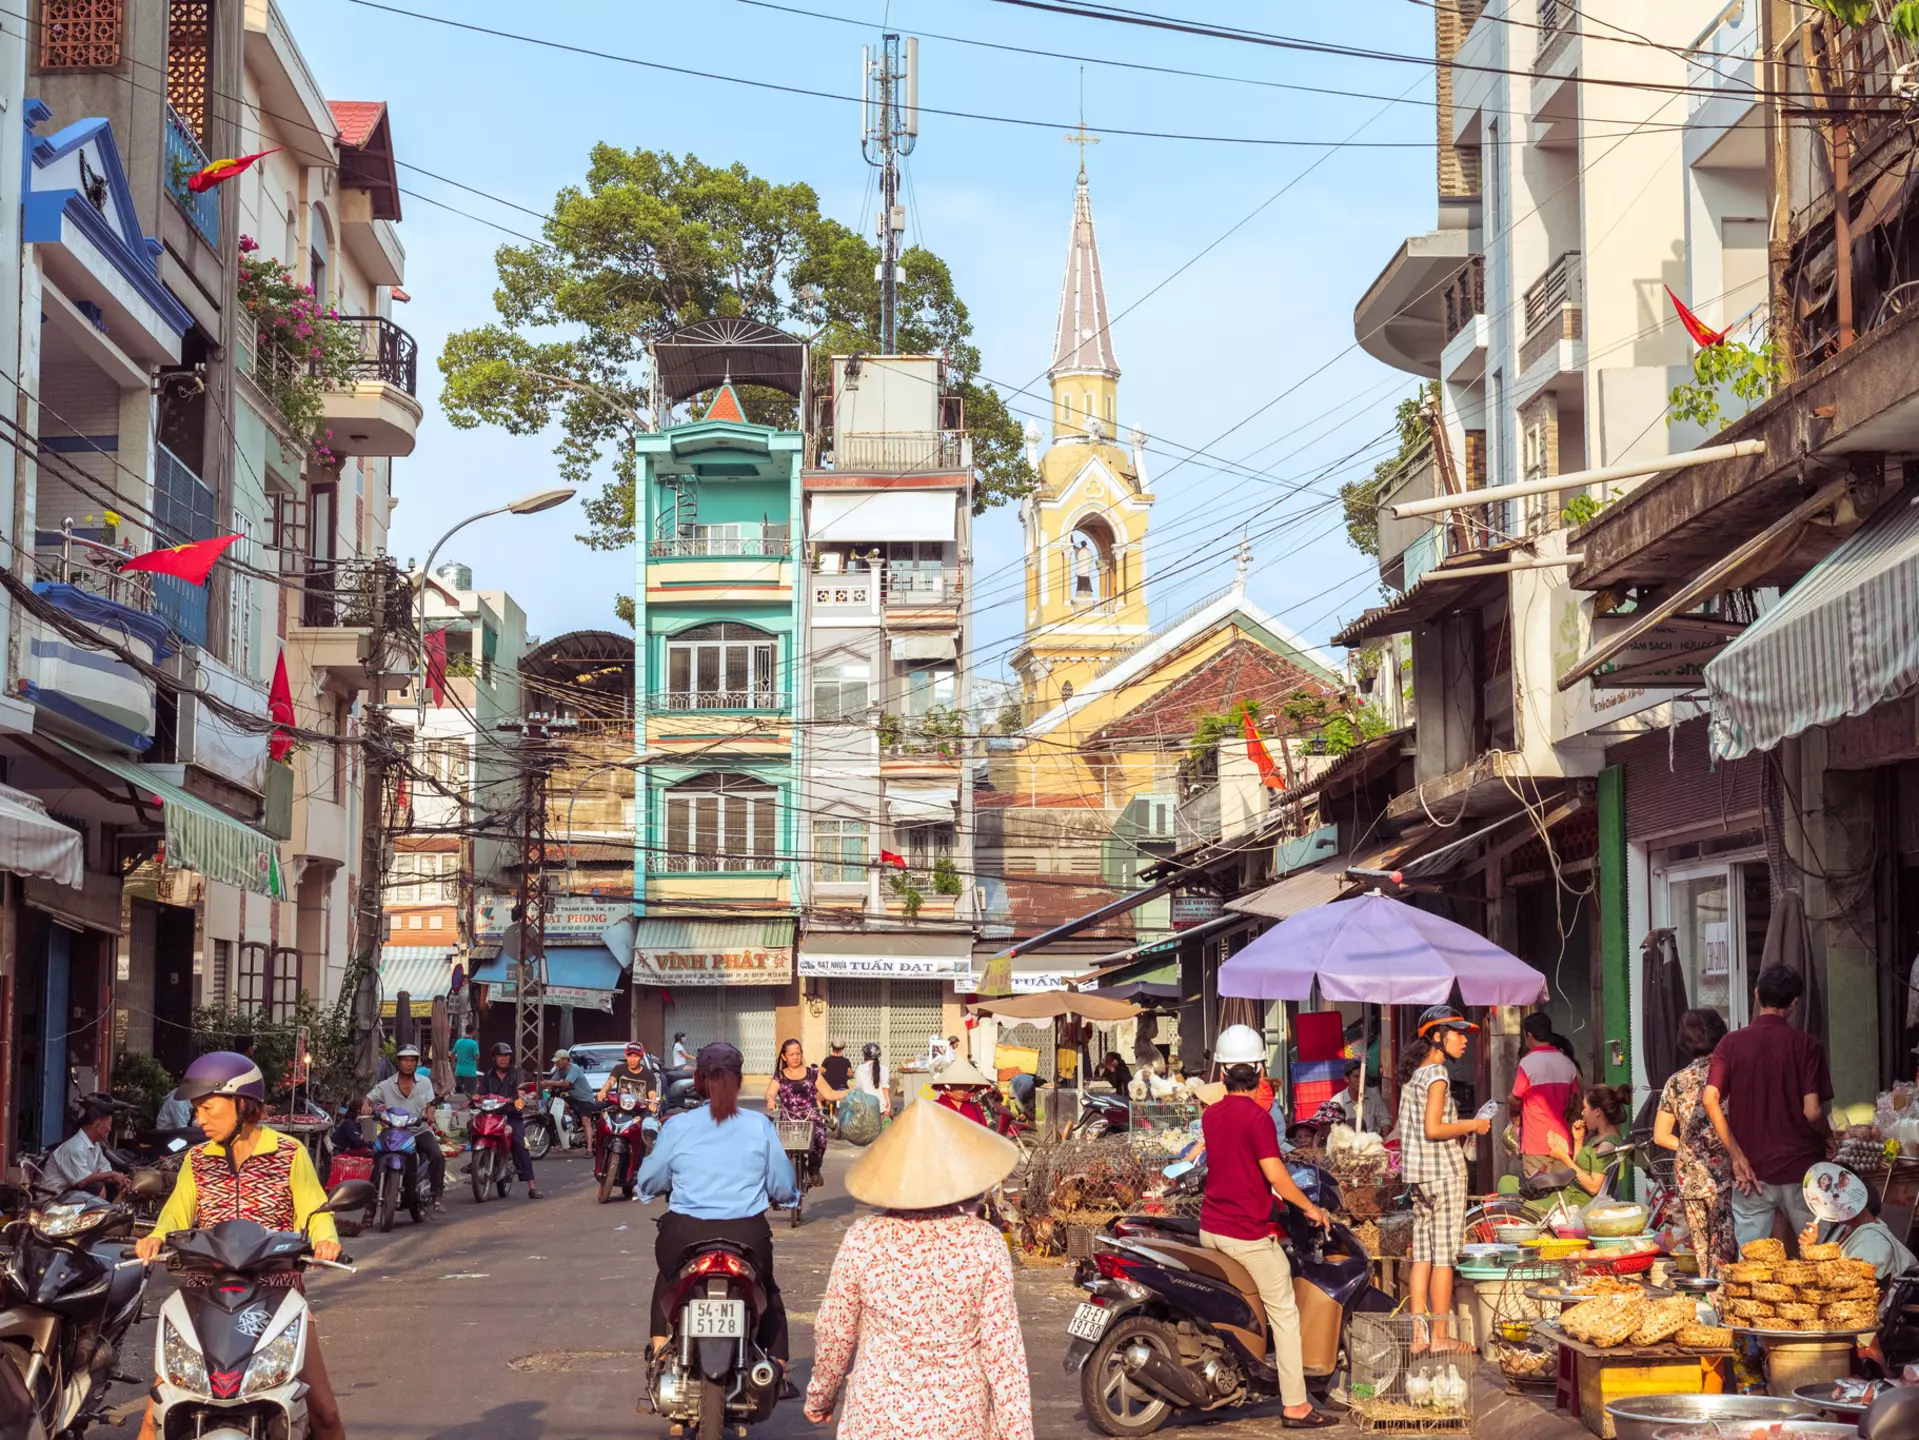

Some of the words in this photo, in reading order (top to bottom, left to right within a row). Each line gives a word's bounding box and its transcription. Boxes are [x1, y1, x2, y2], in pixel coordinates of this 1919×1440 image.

[258, 852, 270, 873] 6
[567, 913, 608, 924] PHONG
[653, 950, 708, 971] VĨNH
[849, 958, 894, 971] TUẤN
[899, 962, 934, 974] ĐẠT
[697, 1319, 736, 1334] 5128
[1069, 1319, 1101, 1340] 191.90
